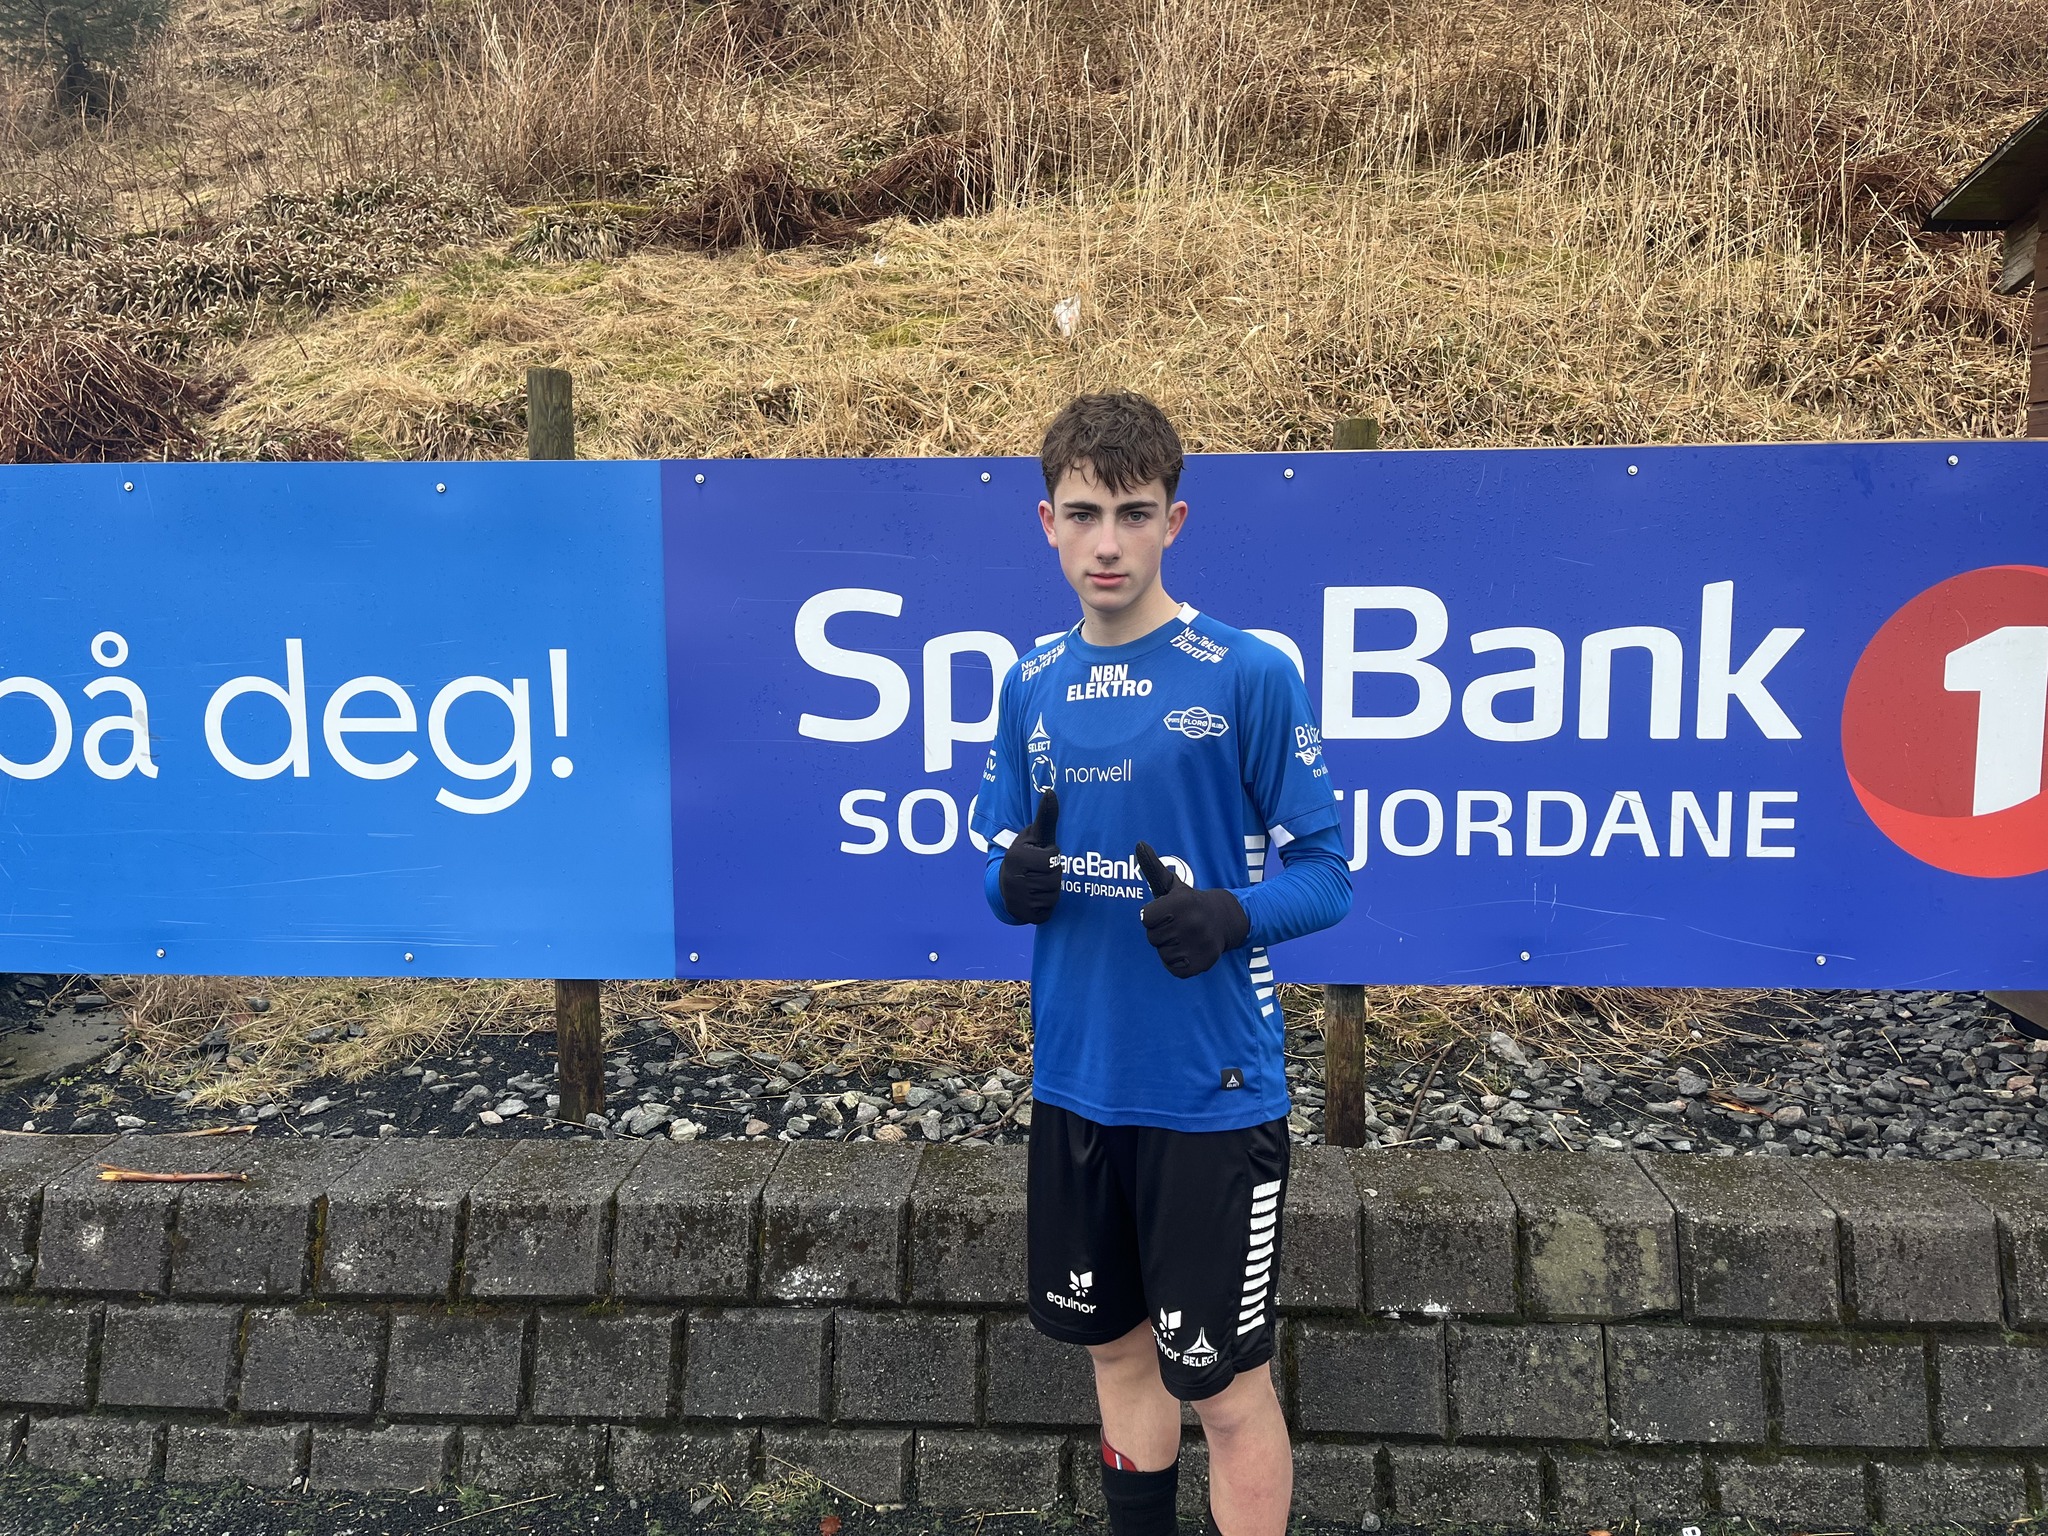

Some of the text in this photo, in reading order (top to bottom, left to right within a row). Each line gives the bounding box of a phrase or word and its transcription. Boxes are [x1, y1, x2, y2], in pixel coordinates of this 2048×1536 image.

[1180, 626, 1229, 657] Nor Tekstil
[1021, 657, 1038, 671] Nor
[1090, 664, 1129, 683] NBN
[794, 580, 2048, 816] SpBank 1
[1066, 679, 1153, 702] ELEKTRO
[204, 638, 574, 815] deg!
[1027, 740, 1051, 754] SELECT
[1065, 759, 1132, 783] norwell
[1333, 787, 1800, 872] JORDANE
[1060, 851, 1143, 881] areBank
[1065, 880, 1081, 893] OG
[1084, 882, 1144, 900] FJORDANE
[1046, 1290, 1097, 1315] equinor
[1182, 1351, 1219, 1368] SELECT
